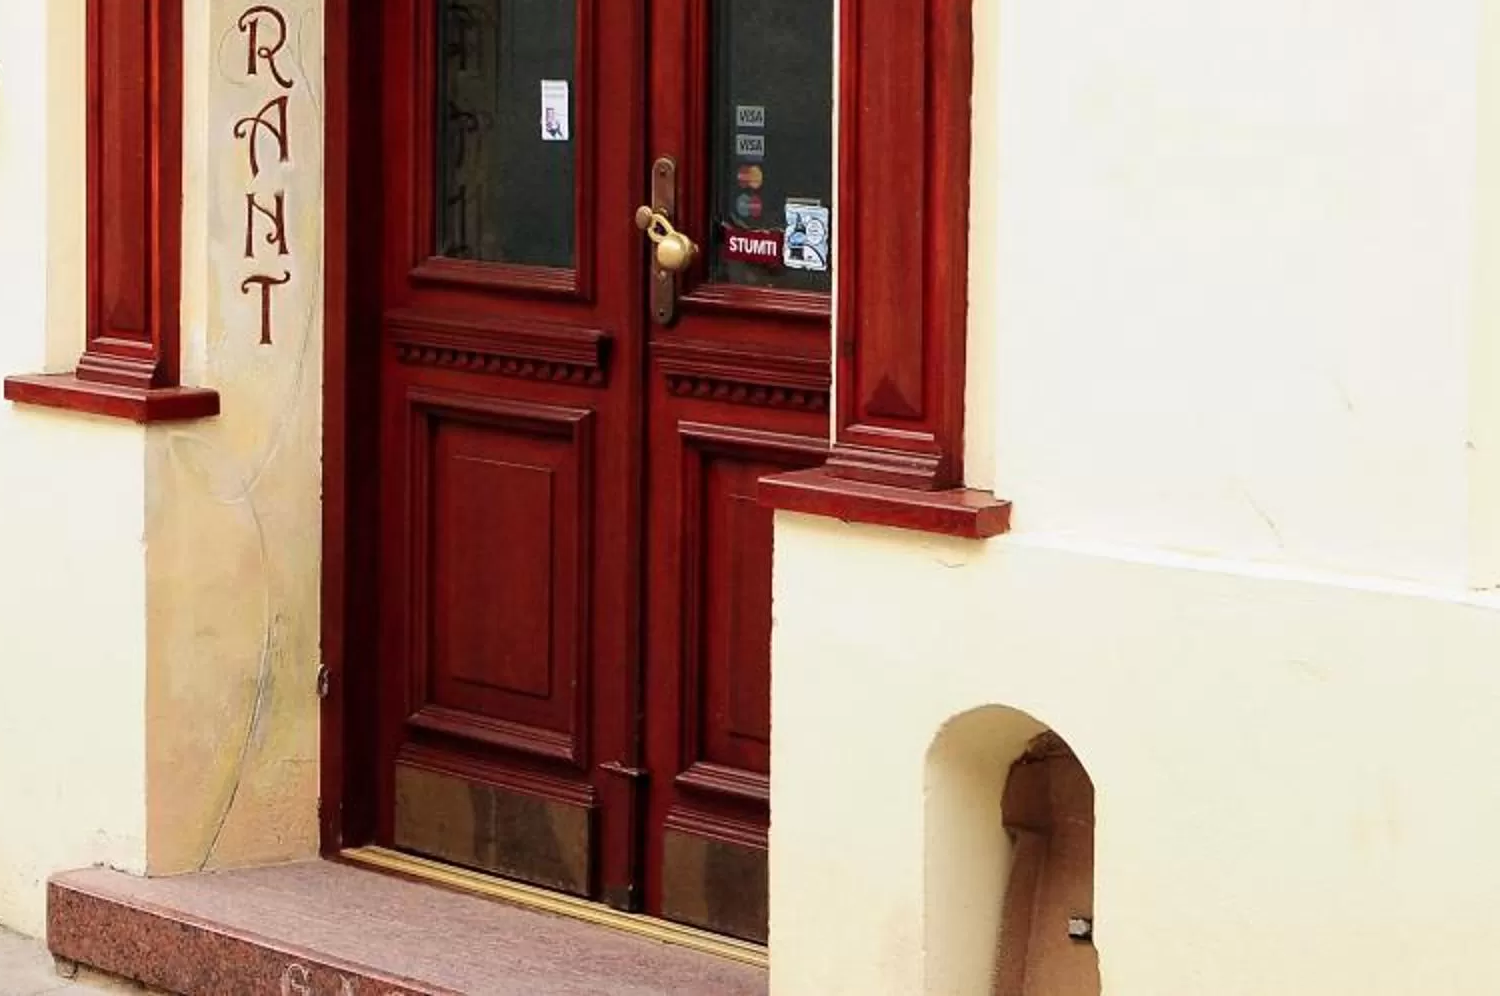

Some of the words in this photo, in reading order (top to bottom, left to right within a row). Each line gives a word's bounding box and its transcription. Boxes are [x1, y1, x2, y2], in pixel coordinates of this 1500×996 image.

[739, 107, 764, 123] VISA
[739, 138, 764, 153] VISA
[729, 235, 777, 257] STUMTI
